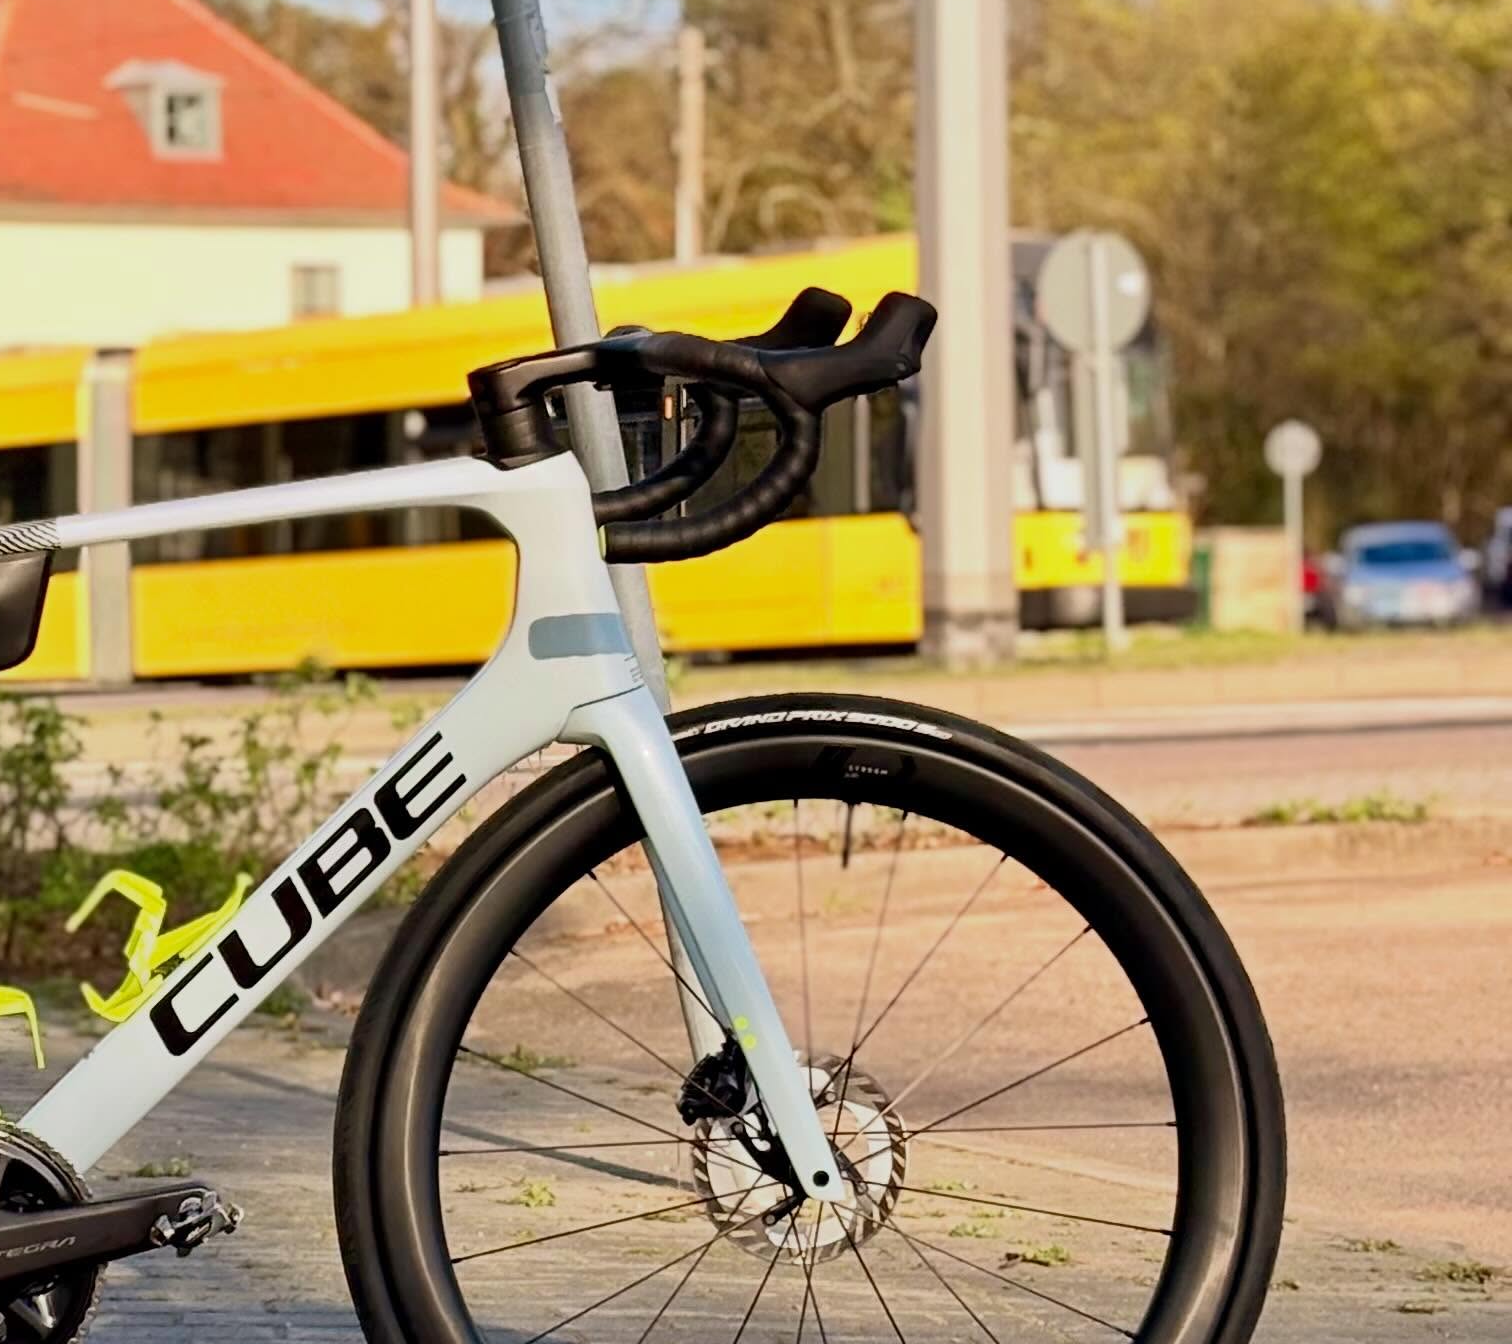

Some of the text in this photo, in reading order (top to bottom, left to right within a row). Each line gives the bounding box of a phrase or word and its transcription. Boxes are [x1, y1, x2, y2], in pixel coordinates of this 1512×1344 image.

[704, 711, 788, 735] GRAND
[786, 709, 849, 722] PRIX
[149, 730, 468, 1057] CUBE
